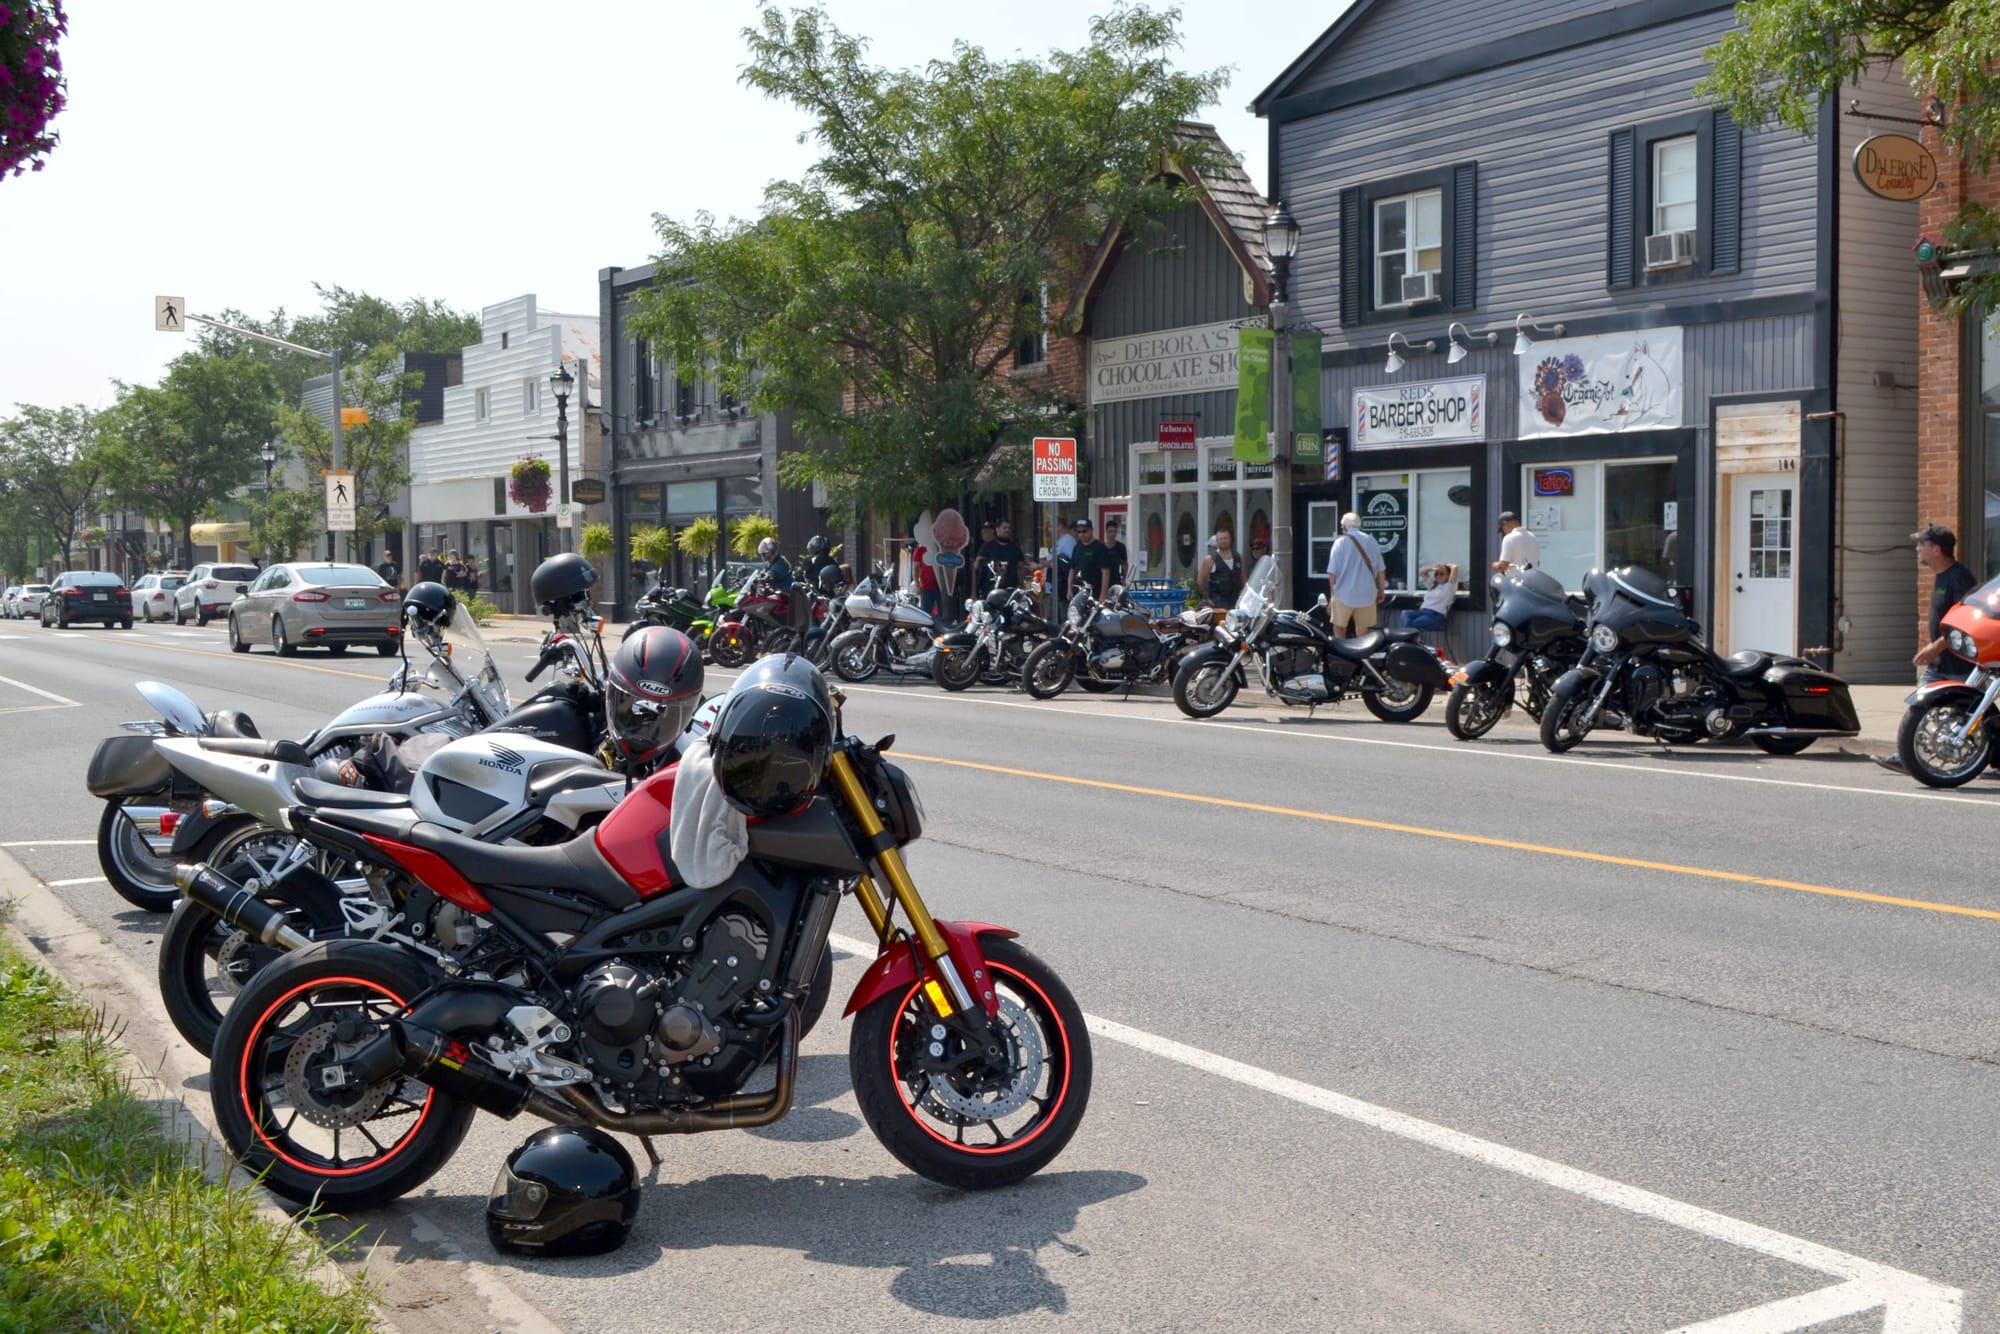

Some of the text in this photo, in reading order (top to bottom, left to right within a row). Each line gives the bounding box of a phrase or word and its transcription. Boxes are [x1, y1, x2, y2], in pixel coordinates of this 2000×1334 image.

[1125, 328, 1229, 361] DEBORA'S
[1098, 354, 1203, 387] CHOCOLATE
[1370, 397, 1466, 429] BARBER SHOP
[1048, 442, 1061, 456] NO
[1159, 441, 1194, 449] CHOCOLATES
[1297, 440, 1319, 451] ERIN
[1036, 457, 1073, 471] PASSING
[1040, 475, 1070, 486] HERE TO
[1536, 473, 1571, 490] Tattoo
[1039, 486, 1072, 496] CROSSING
[641, 682, 668, 694] HJC
[478, 758, 522, 776] HONDA
